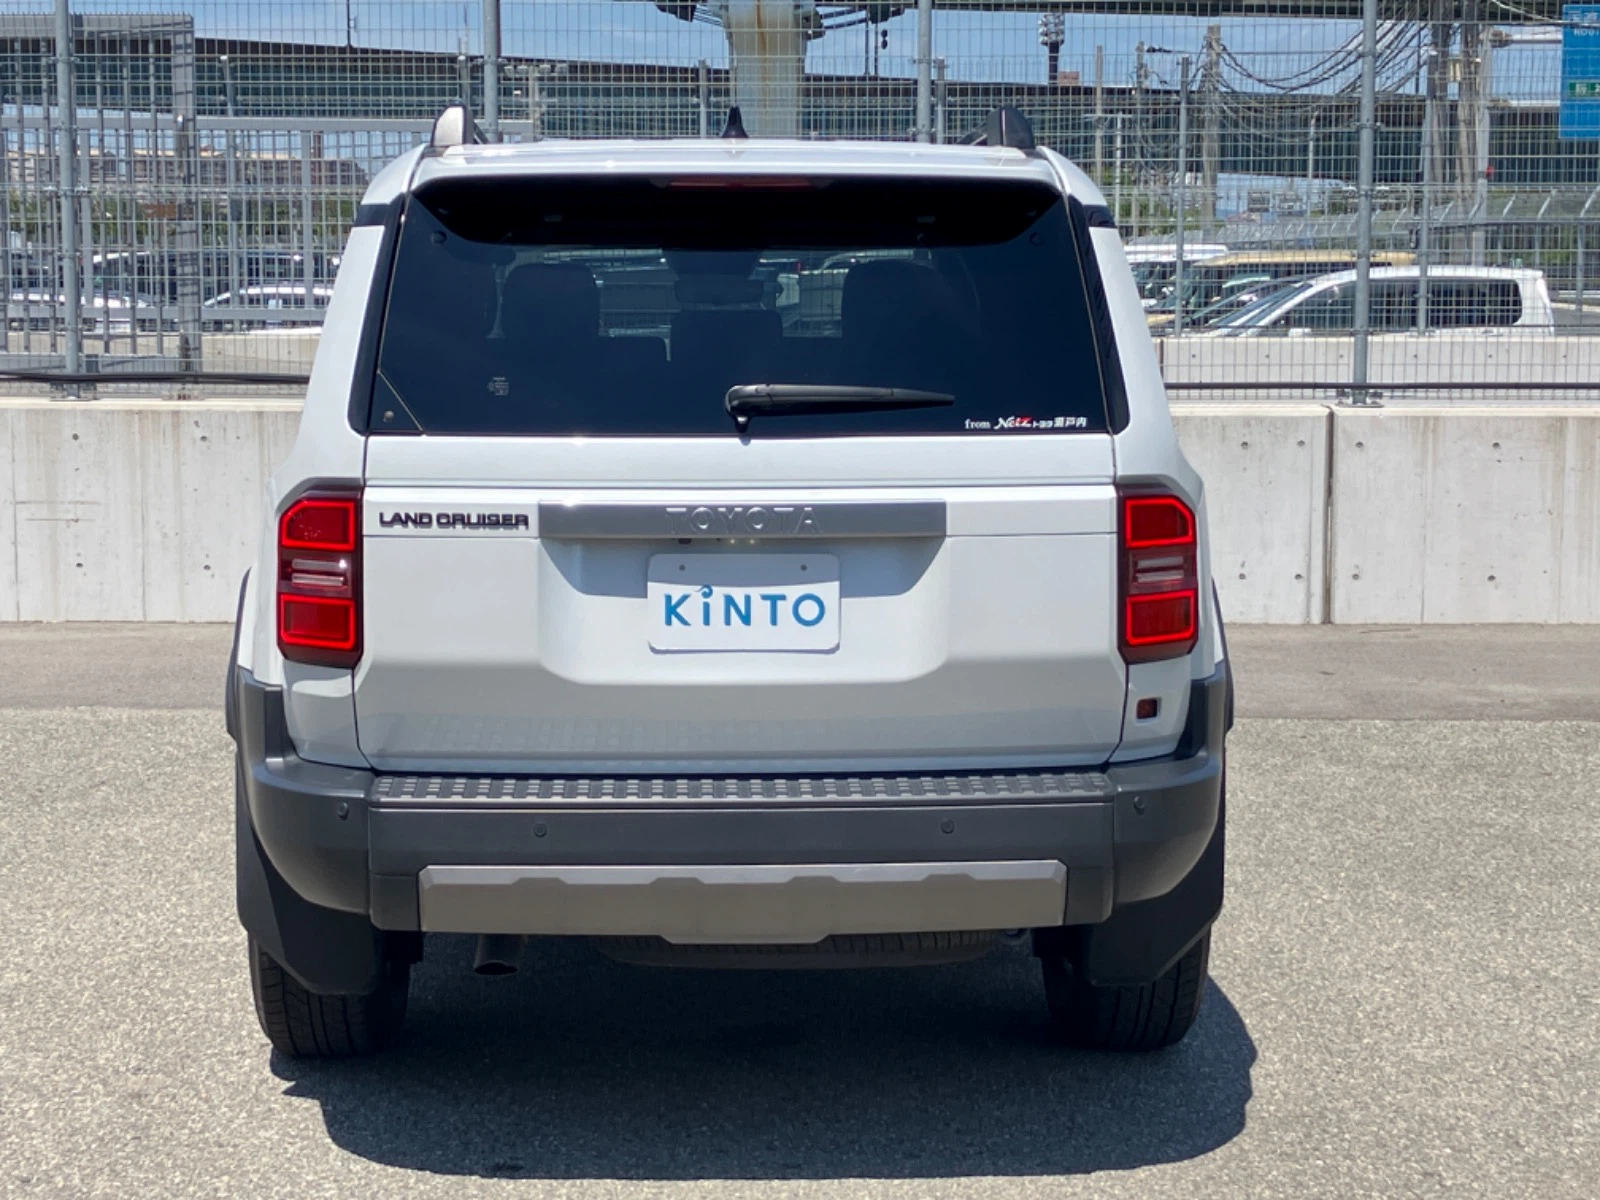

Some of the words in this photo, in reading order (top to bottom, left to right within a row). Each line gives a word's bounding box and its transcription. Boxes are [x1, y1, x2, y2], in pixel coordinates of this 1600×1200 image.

[965, 418, 991, 430] from
[993, 416, 1032, 430] Netz
[379, 512, 432, 528] LAND
[436, 512, 529, 530] CRUISER
[665, 506, 824, 534] TOYOTA
